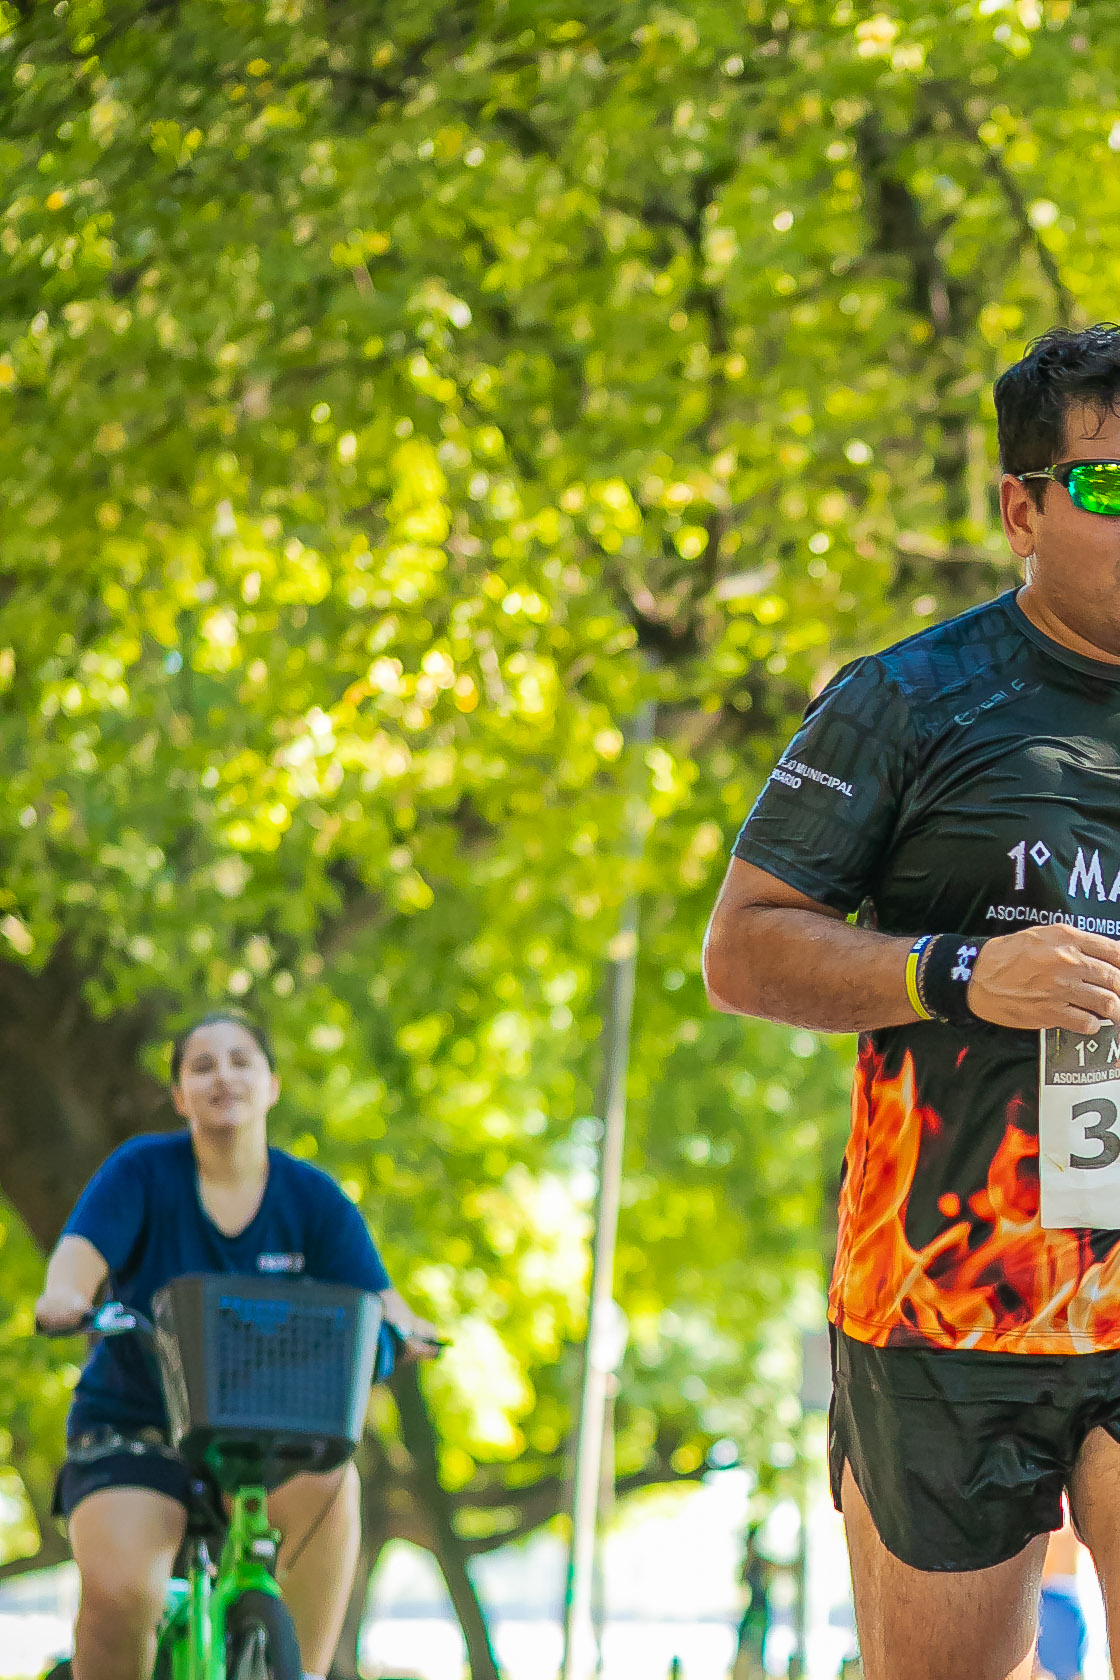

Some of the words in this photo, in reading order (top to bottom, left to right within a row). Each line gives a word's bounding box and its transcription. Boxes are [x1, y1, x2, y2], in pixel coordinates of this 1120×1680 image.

[797, 762, 853, 797] MUNICIPAL
[986, 904, 1075, 927] ASOCIACIÓN
[1053, 1068, 1107, 1084] ASOCIACIÓN
